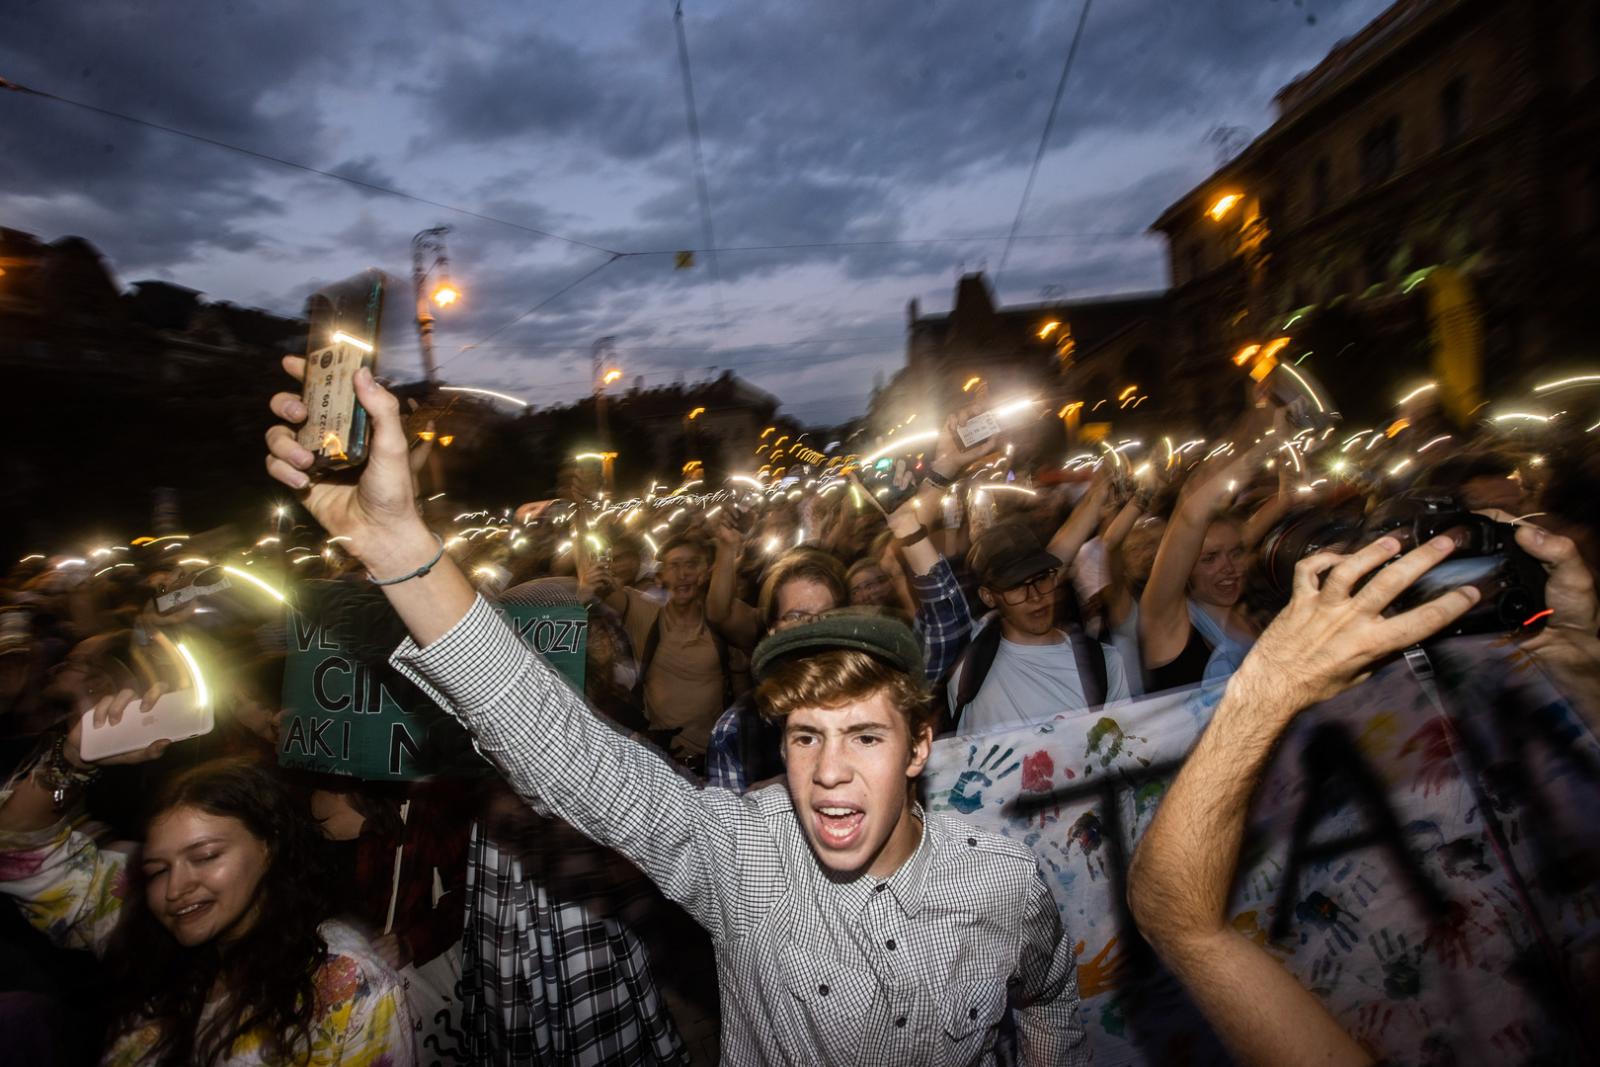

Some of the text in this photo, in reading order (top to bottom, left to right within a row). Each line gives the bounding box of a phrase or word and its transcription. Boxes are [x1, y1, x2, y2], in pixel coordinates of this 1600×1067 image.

[513, 614, 588, 655] KÖZT
[312, 655, 416, 714] CIN
[283, 715, 351, 761] AKI
